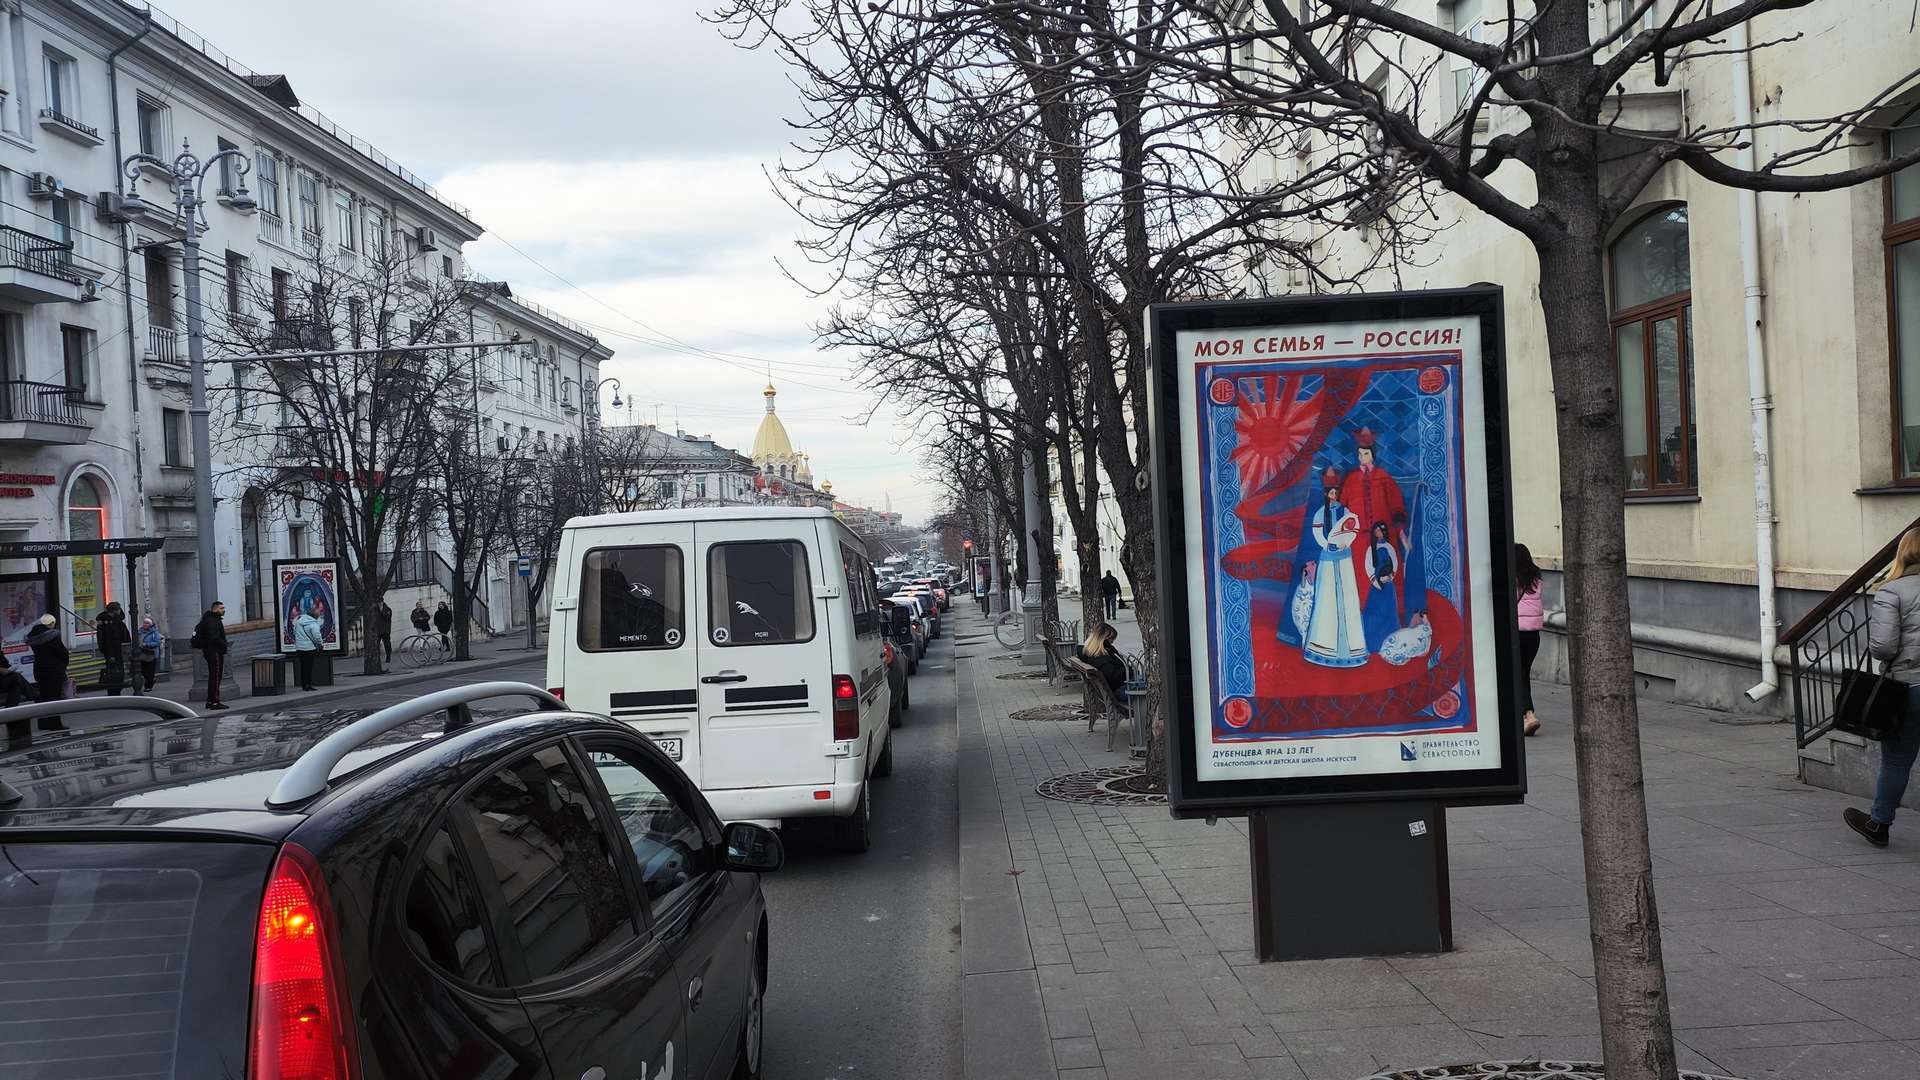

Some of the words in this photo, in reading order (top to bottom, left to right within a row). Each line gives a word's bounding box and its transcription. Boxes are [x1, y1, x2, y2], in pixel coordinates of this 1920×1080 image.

[1194, 340, 1245, 357] МОЯ
[1253, 335, 1325, 354] СЕМЬЯ
[1364, 328, 1462, 348] РОССИЯ!
[661, 741, 675, 752] 92
[1422, 739, 1480, 748] ПРАВИТЕЛЬСТВО
[1212, 750, 1263, 759] ДУБЕНЦЕВА
[1266, 748, 1282, 756] ЯНА
[1286, 747, 1297, 755] 13
[1299, 746, 1315, 754] ЛЕТ
[1422, 749, 1481, 758] СЕВАСТОПОЛЯ
[1213, 759, 1272, 767] СЕВАСТОПОЛЬСКАЯ
